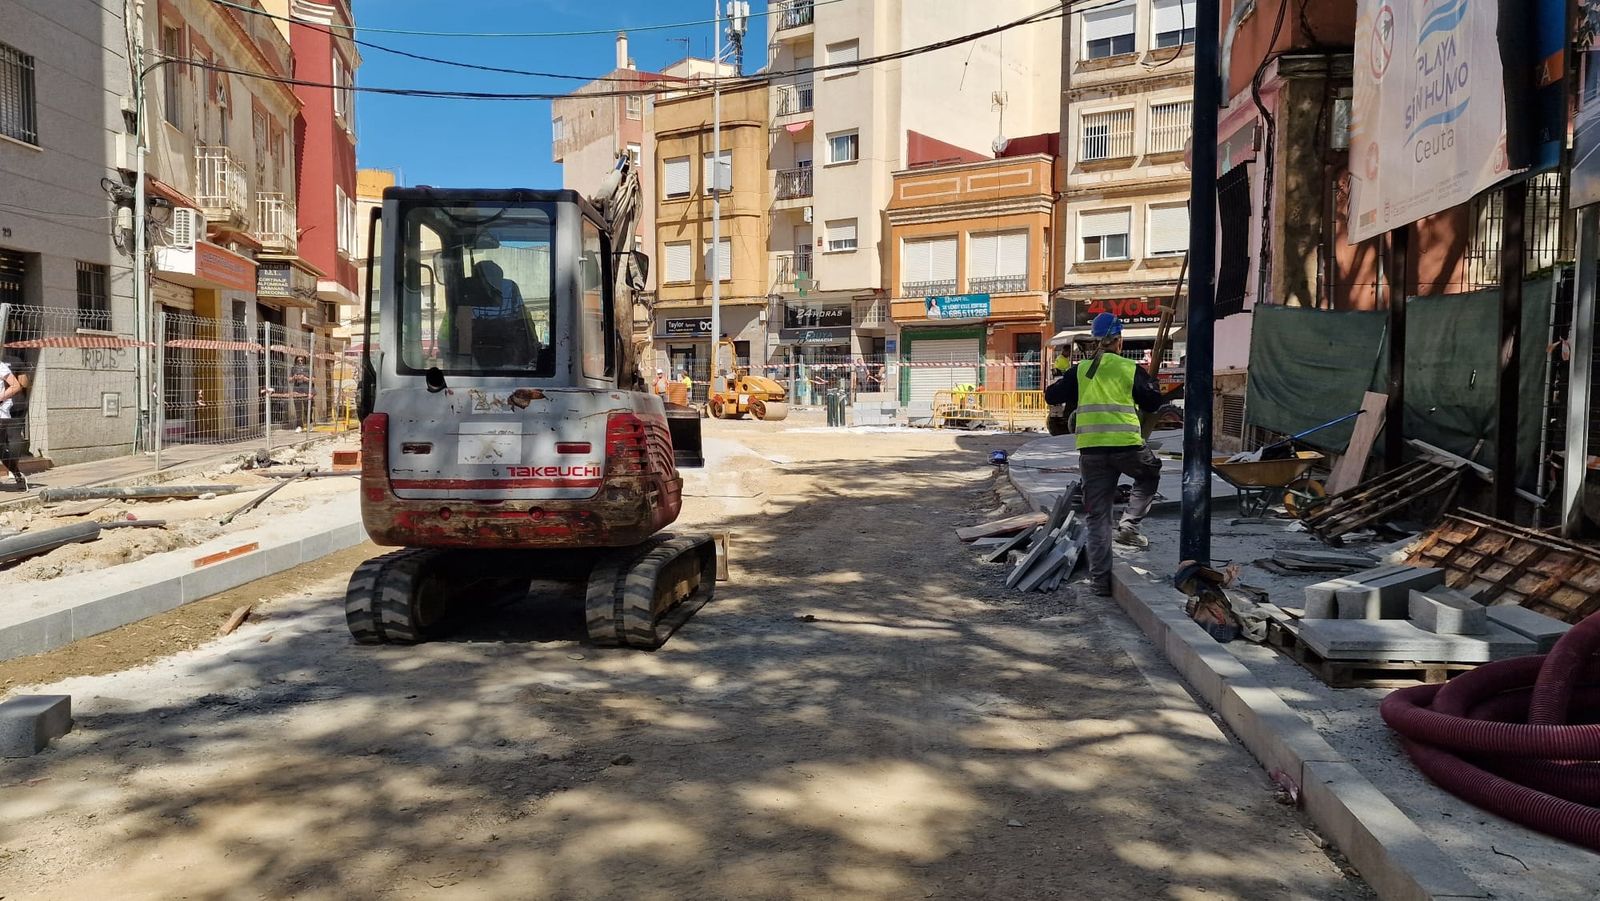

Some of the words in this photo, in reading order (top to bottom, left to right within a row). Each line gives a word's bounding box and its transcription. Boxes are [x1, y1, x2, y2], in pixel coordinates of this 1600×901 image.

[1416, 34, 1457, 76] PLAYA
[1404, 86, 1424, 129] SIN
[1425, 62, 1469, 108] HUMO
[1415, 128, 1455, 163] Ceuta
[668, 321, 684, 329] Taylor
[796, 309, 812, 318] 24
[813, 310, 843, 318] HORAS
